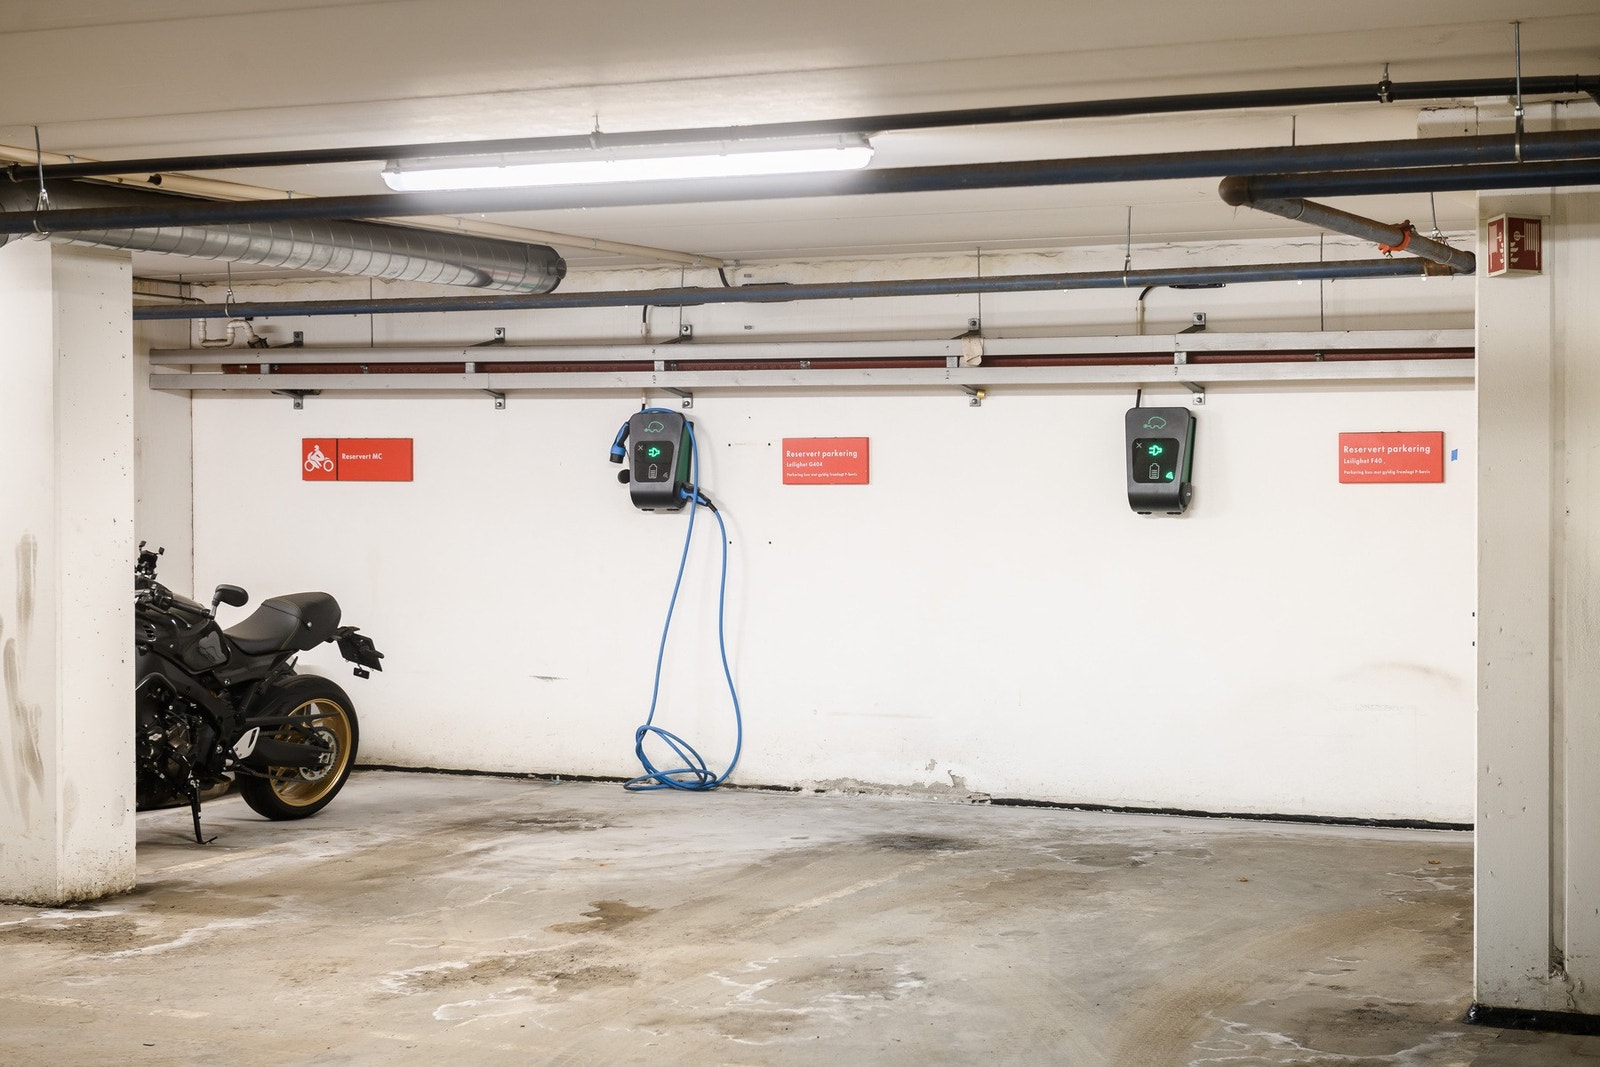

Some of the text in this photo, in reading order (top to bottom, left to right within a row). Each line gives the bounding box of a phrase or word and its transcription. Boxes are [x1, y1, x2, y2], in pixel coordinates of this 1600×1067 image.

[822, 449, 858, 459] parkering
[1343, 444, 1431, 455] Reservert parkering
[1343, 457, 1370, 465] Leilighet
